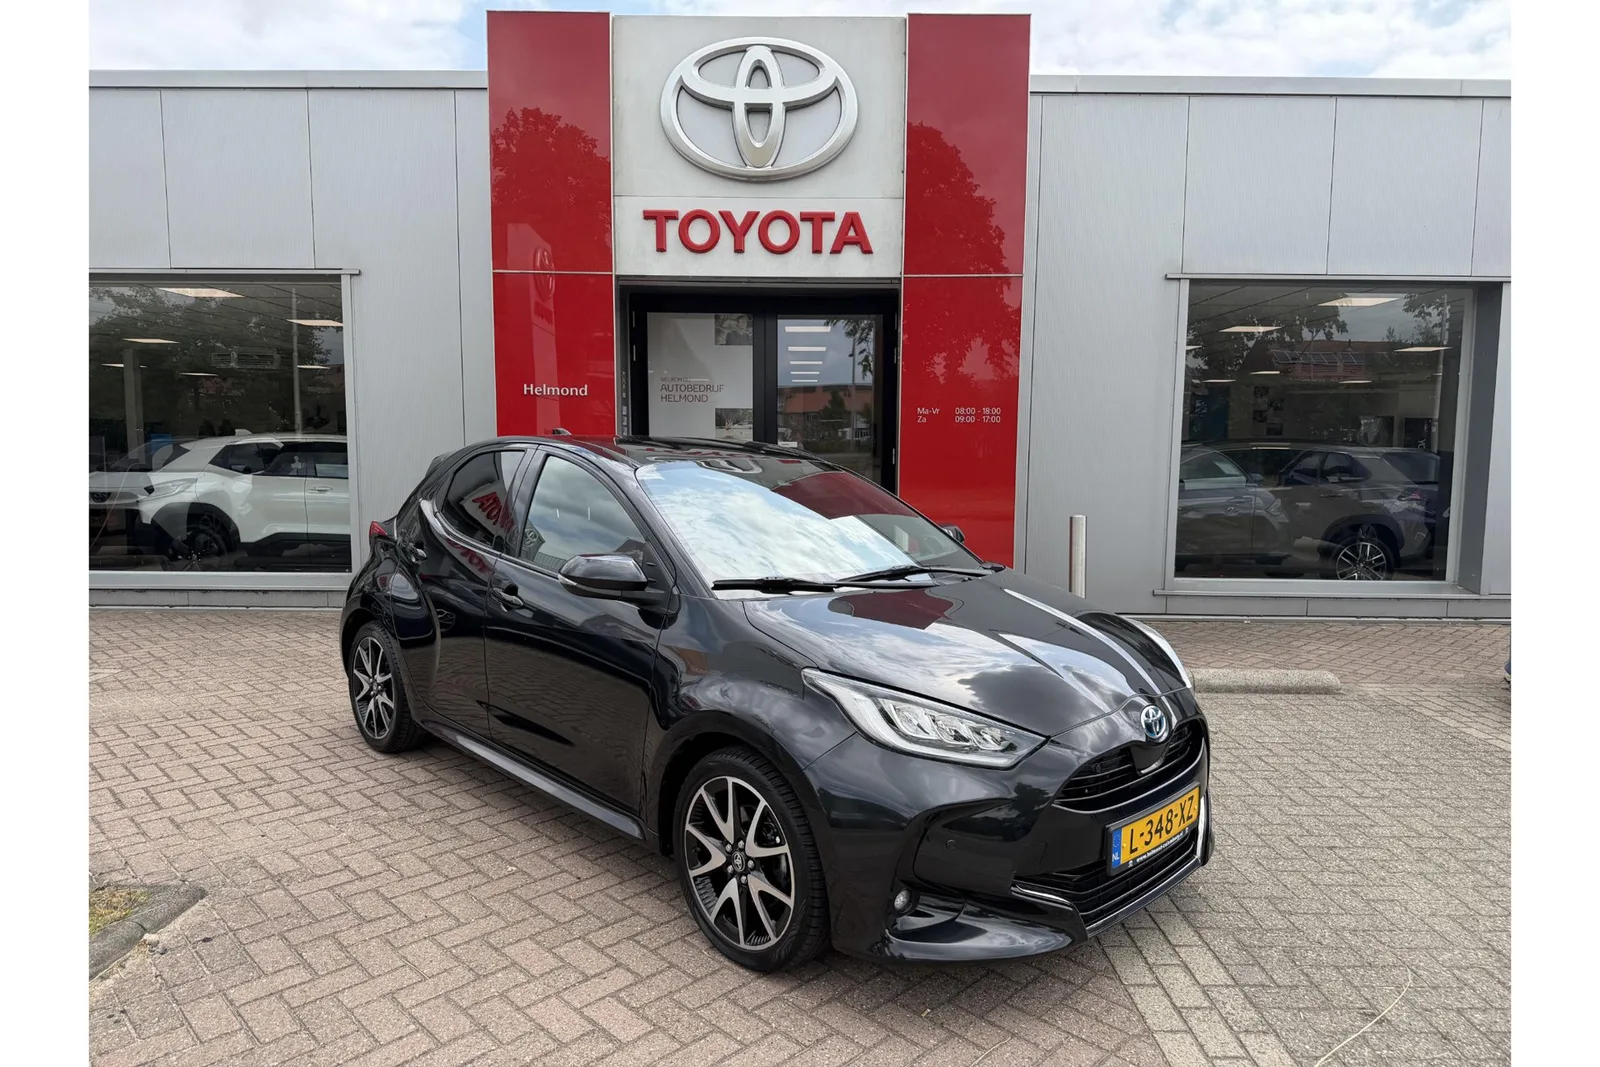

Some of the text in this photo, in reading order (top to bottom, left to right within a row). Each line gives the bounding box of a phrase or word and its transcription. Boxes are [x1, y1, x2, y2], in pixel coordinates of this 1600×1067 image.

[643, 209, 873, 254] TOYOTA
[523, 383, 588, 396] Helmond
[660, 394, 709, 403] HELMOND
[917, 407, 940, 415] Ma-Vr
[955, 407, 975, 415] 08:00
[982, 407, 1001, 415] 18:00
[917, 415, 927, 423] Za
[955, 415, 975, 423] 09:00
[982, 415, 1001, 423] 17:00
[1129, 795, 1194, 855] L-348-XZ
[1112, 851, 1120, 862] NL
